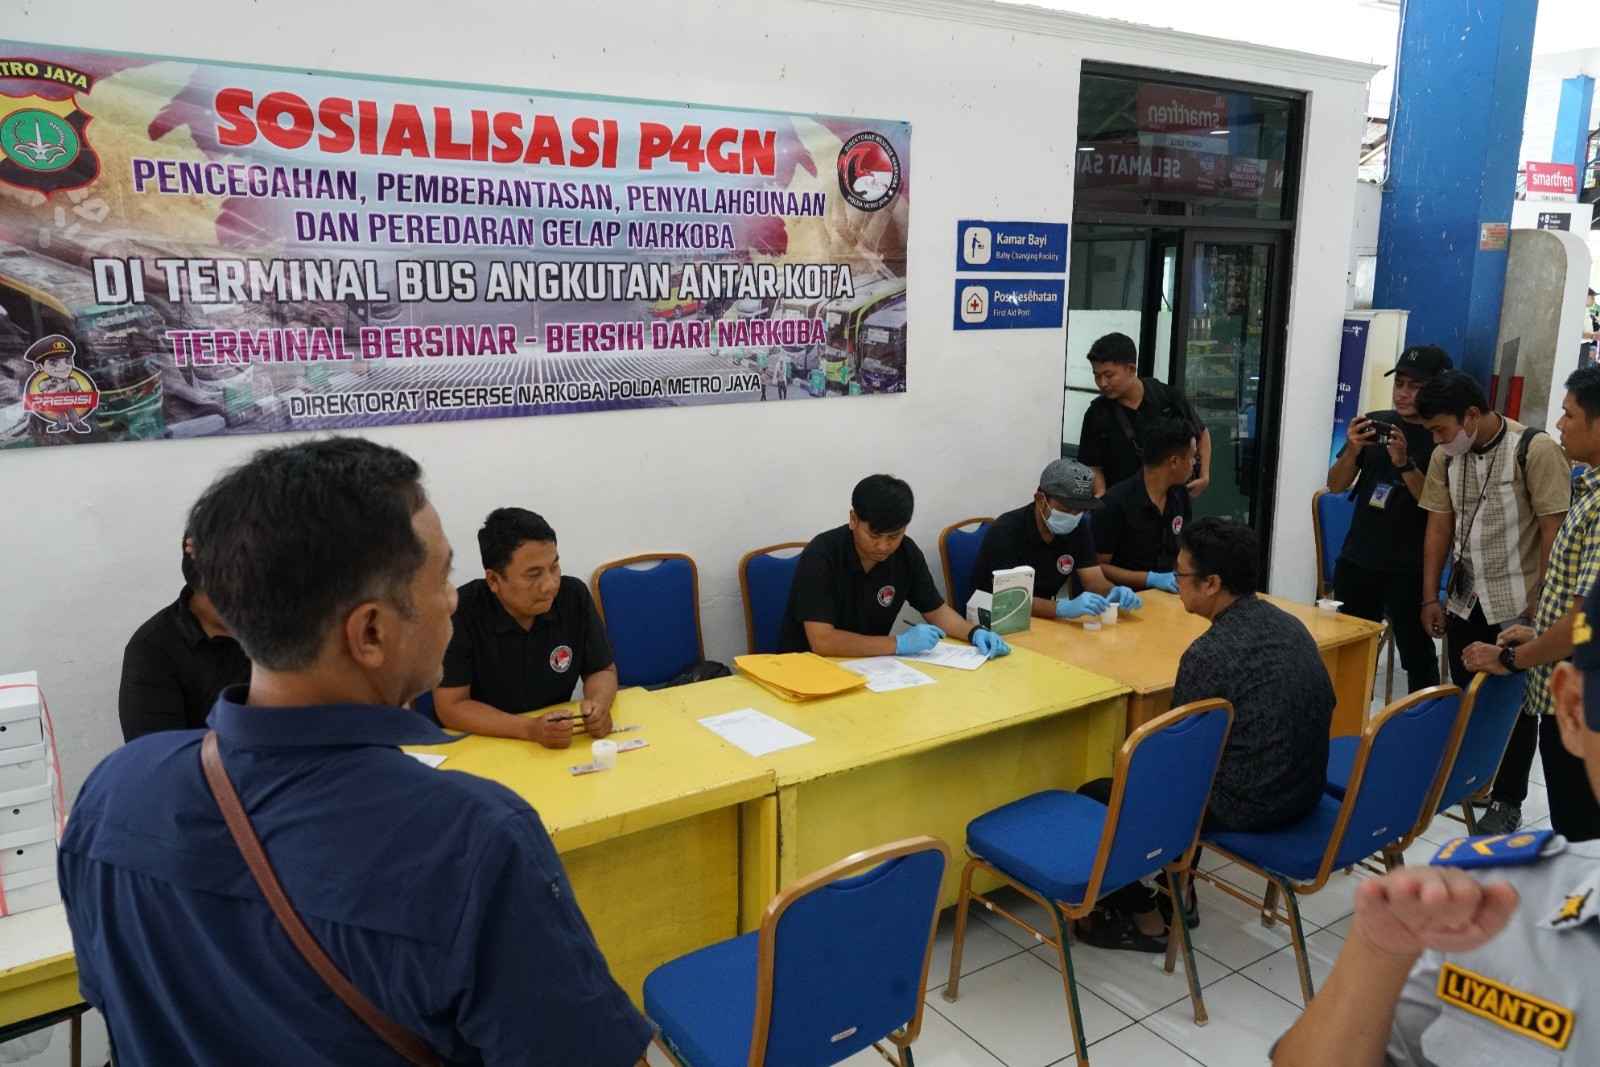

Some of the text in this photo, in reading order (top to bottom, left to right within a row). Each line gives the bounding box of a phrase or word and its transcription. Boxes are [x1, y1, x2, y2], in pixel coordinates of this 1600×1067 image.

[0, 61, 88, 89] TRO JAYA
[215, 87, 776, 176] SOSIALISASI P4GN
[133, 158, 826, 217] PENCEGAHAN, PEMBERANTASAN, PENYALAHGUNAAN
[1532, 171, 1574, 188] smartfren
[295, 211, 736, 249] DAN PEREDARAN GELAP NARKOBA
[996, 232, 1048, 248] Kamar Bayi
[996, 251, 1060, 263] Baby Changing Facility
[92, 257, 856, 305] DI TERMINAL BUS ANGKUTAN ANTAR KOTA
[993, 290, 1009, 303] Pos
[993, 308, 1031, 317] First Aid Post
[165, 327, 354, 367] TERMINAL
[360, 323, 518, 361] BERSINAR
[545, 321, 644, 354] BERSIH
[652, 318, 712, 351] DARI
[717, 317, 827, 348] NARKOBA
[31, 394, 93, 407] PRESISI
[289, 373, 761, 418] DIREKTORAT RESERSE NARKOBA POLDA METRO JAYA
[1447, 972, 1561, 1036] LIYANTO
